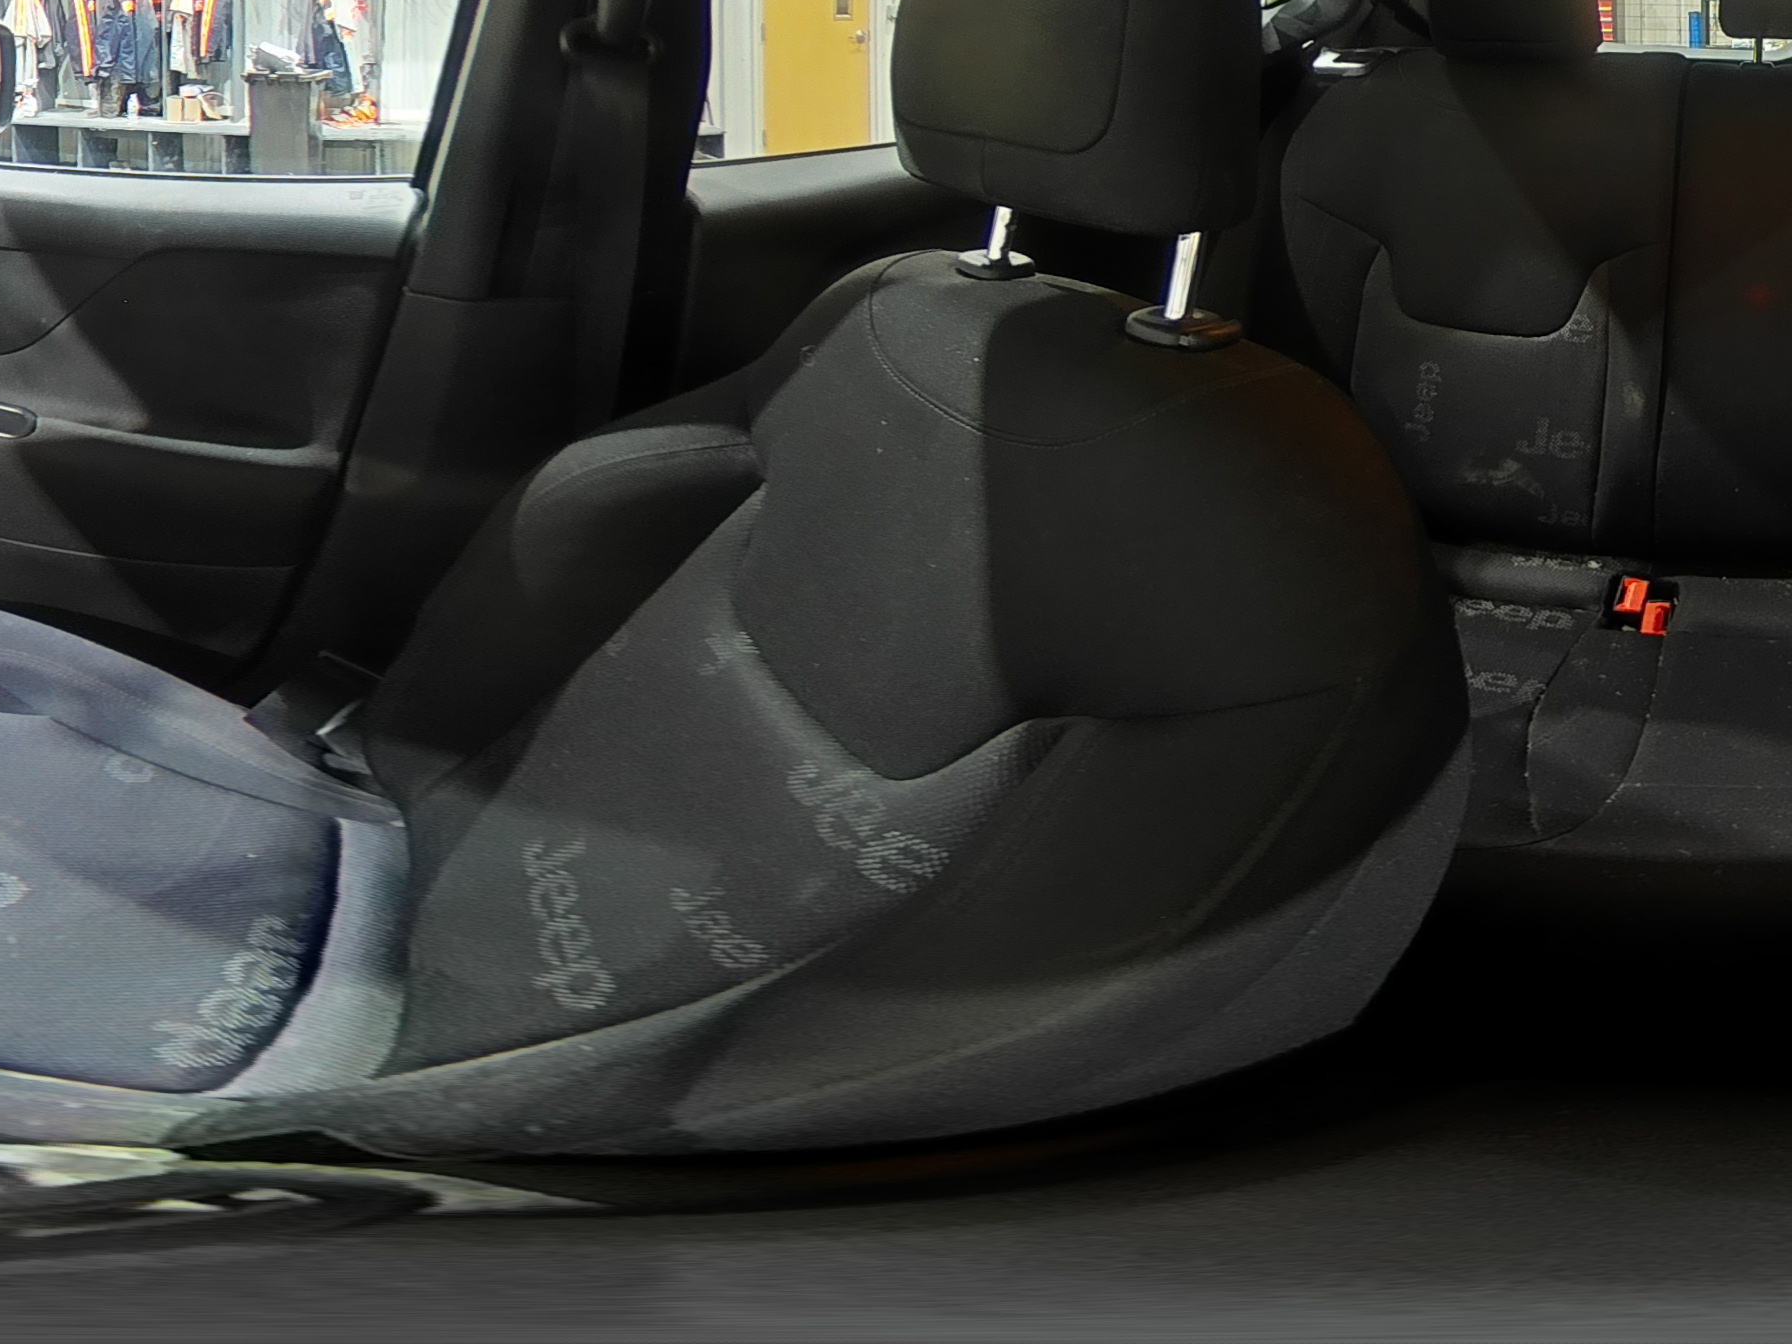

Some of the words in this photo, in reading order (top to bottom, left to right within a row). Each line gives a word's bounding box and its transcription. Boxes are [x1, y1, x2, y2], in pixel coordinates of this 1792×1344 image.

[1404, 360, 1443, 444] Jeep
[1515, 416, 1591, 460] Je
[522, 838, 617, 1010] Jeep
